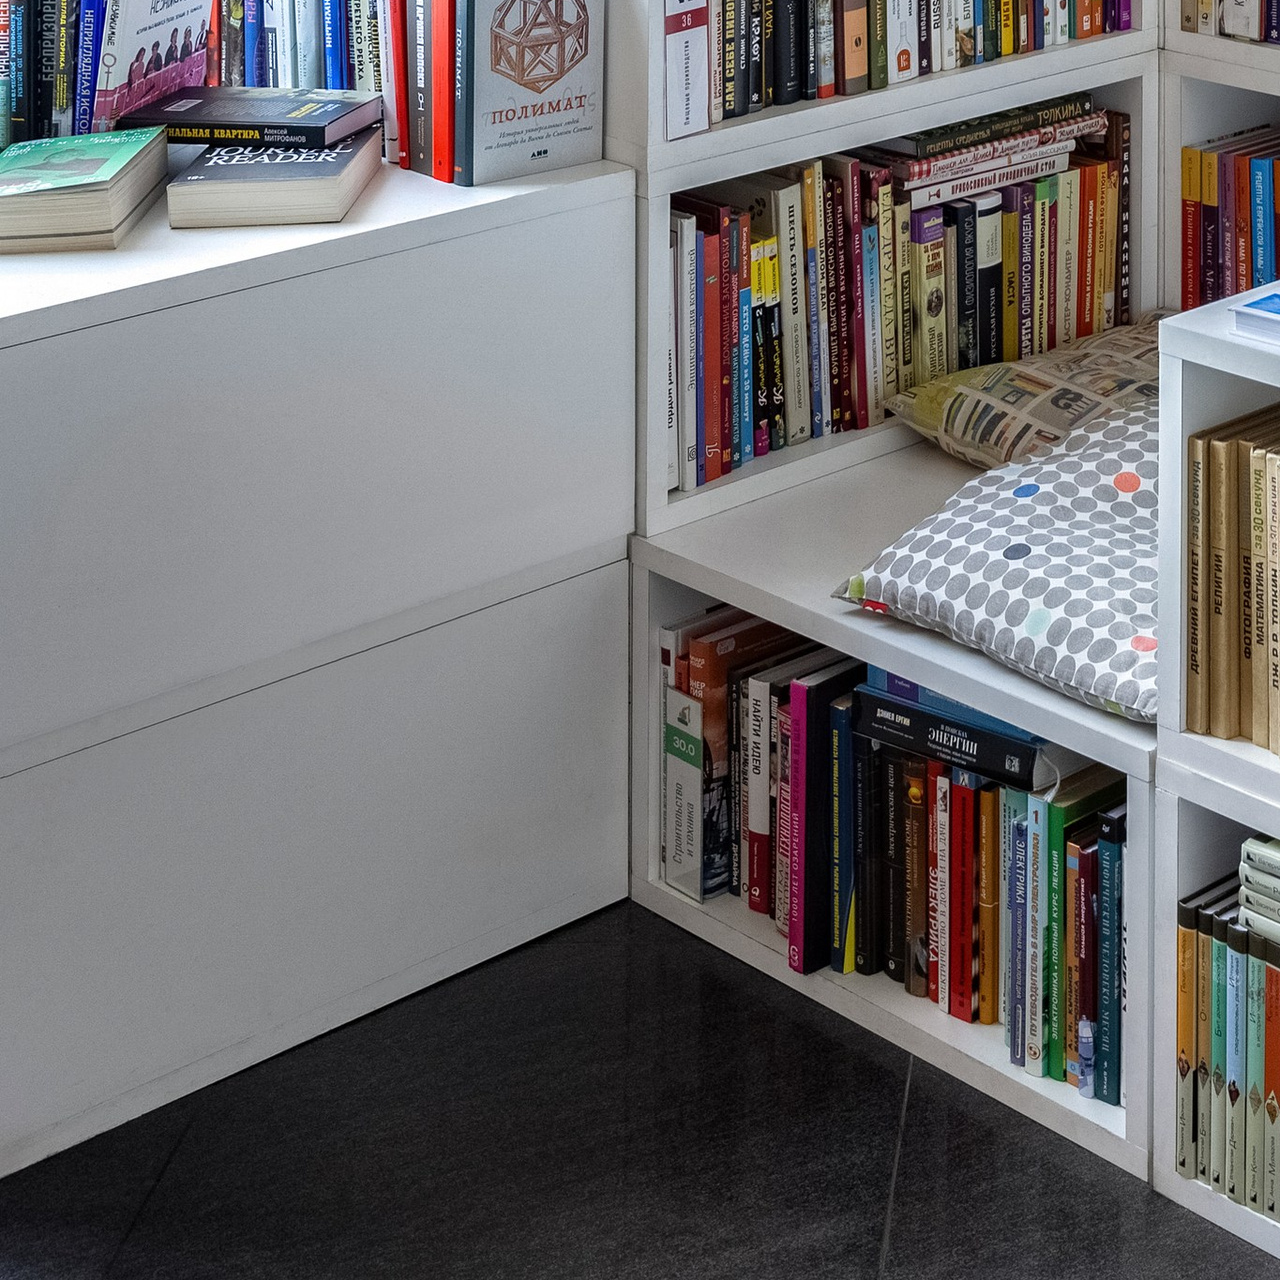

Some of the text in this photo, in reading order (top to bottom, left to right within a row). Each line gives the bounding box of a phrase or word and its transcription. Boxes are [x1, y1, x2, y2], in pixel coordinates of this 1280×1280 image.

[681, 14, 692, 27] 36
[491, 94, 587, 125] ПОЛИМАТ
[215, 126, 261, 140] КВАРТИРА
[264, 134, 307, 143] МИТРОФАНОВ
[204, 150, 338, 166] READER
[1214, 553, 1223, 615] РЕЛИГИИ
[1190, 550, 1200, 675] ДРЕВНИЙ ЕГИПЕТ
[1256, 561, 1264, 646] МАТЕМАТИКА
[672, 735, 695, 757] 30.0
[928, 727, 979, 757] ЭНЕРГИИ
[673, 781, 683, 866] Строительство
